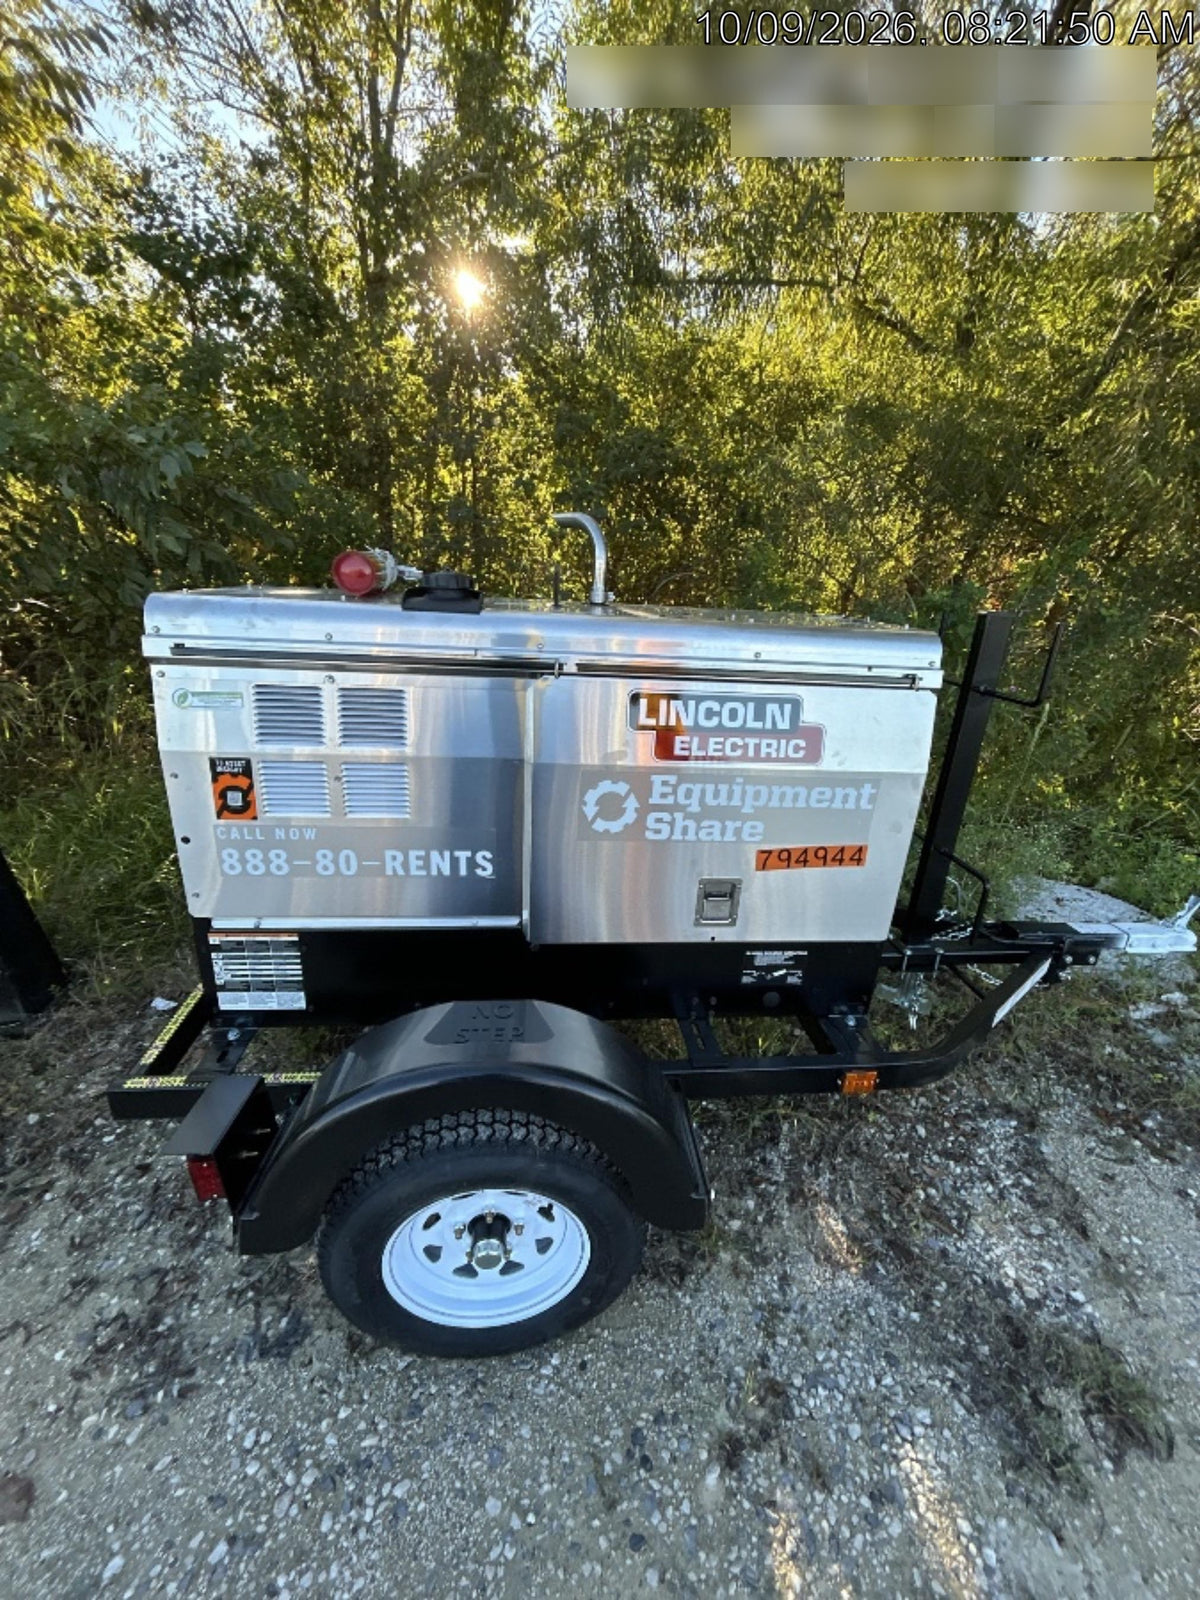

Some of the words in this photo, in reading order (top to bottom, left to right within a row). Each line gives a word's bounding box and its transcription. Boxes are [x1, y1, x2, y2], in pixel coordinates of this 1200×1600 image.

[637, 698, 792, 730] LINCOLN
[672, 735, 807, 759] ELECTRIC
[648, 774, 877, 814] Equipment
[216, 825, 266, 841] CALL
[275, 827, 318, 841] NOW
[645, 811, 764, 842] Share
[221, 847, 495, 878] 888-80-RENTS
[758, 845, 865, 871] 794944
[471, 1004, 514, 1020] NO
